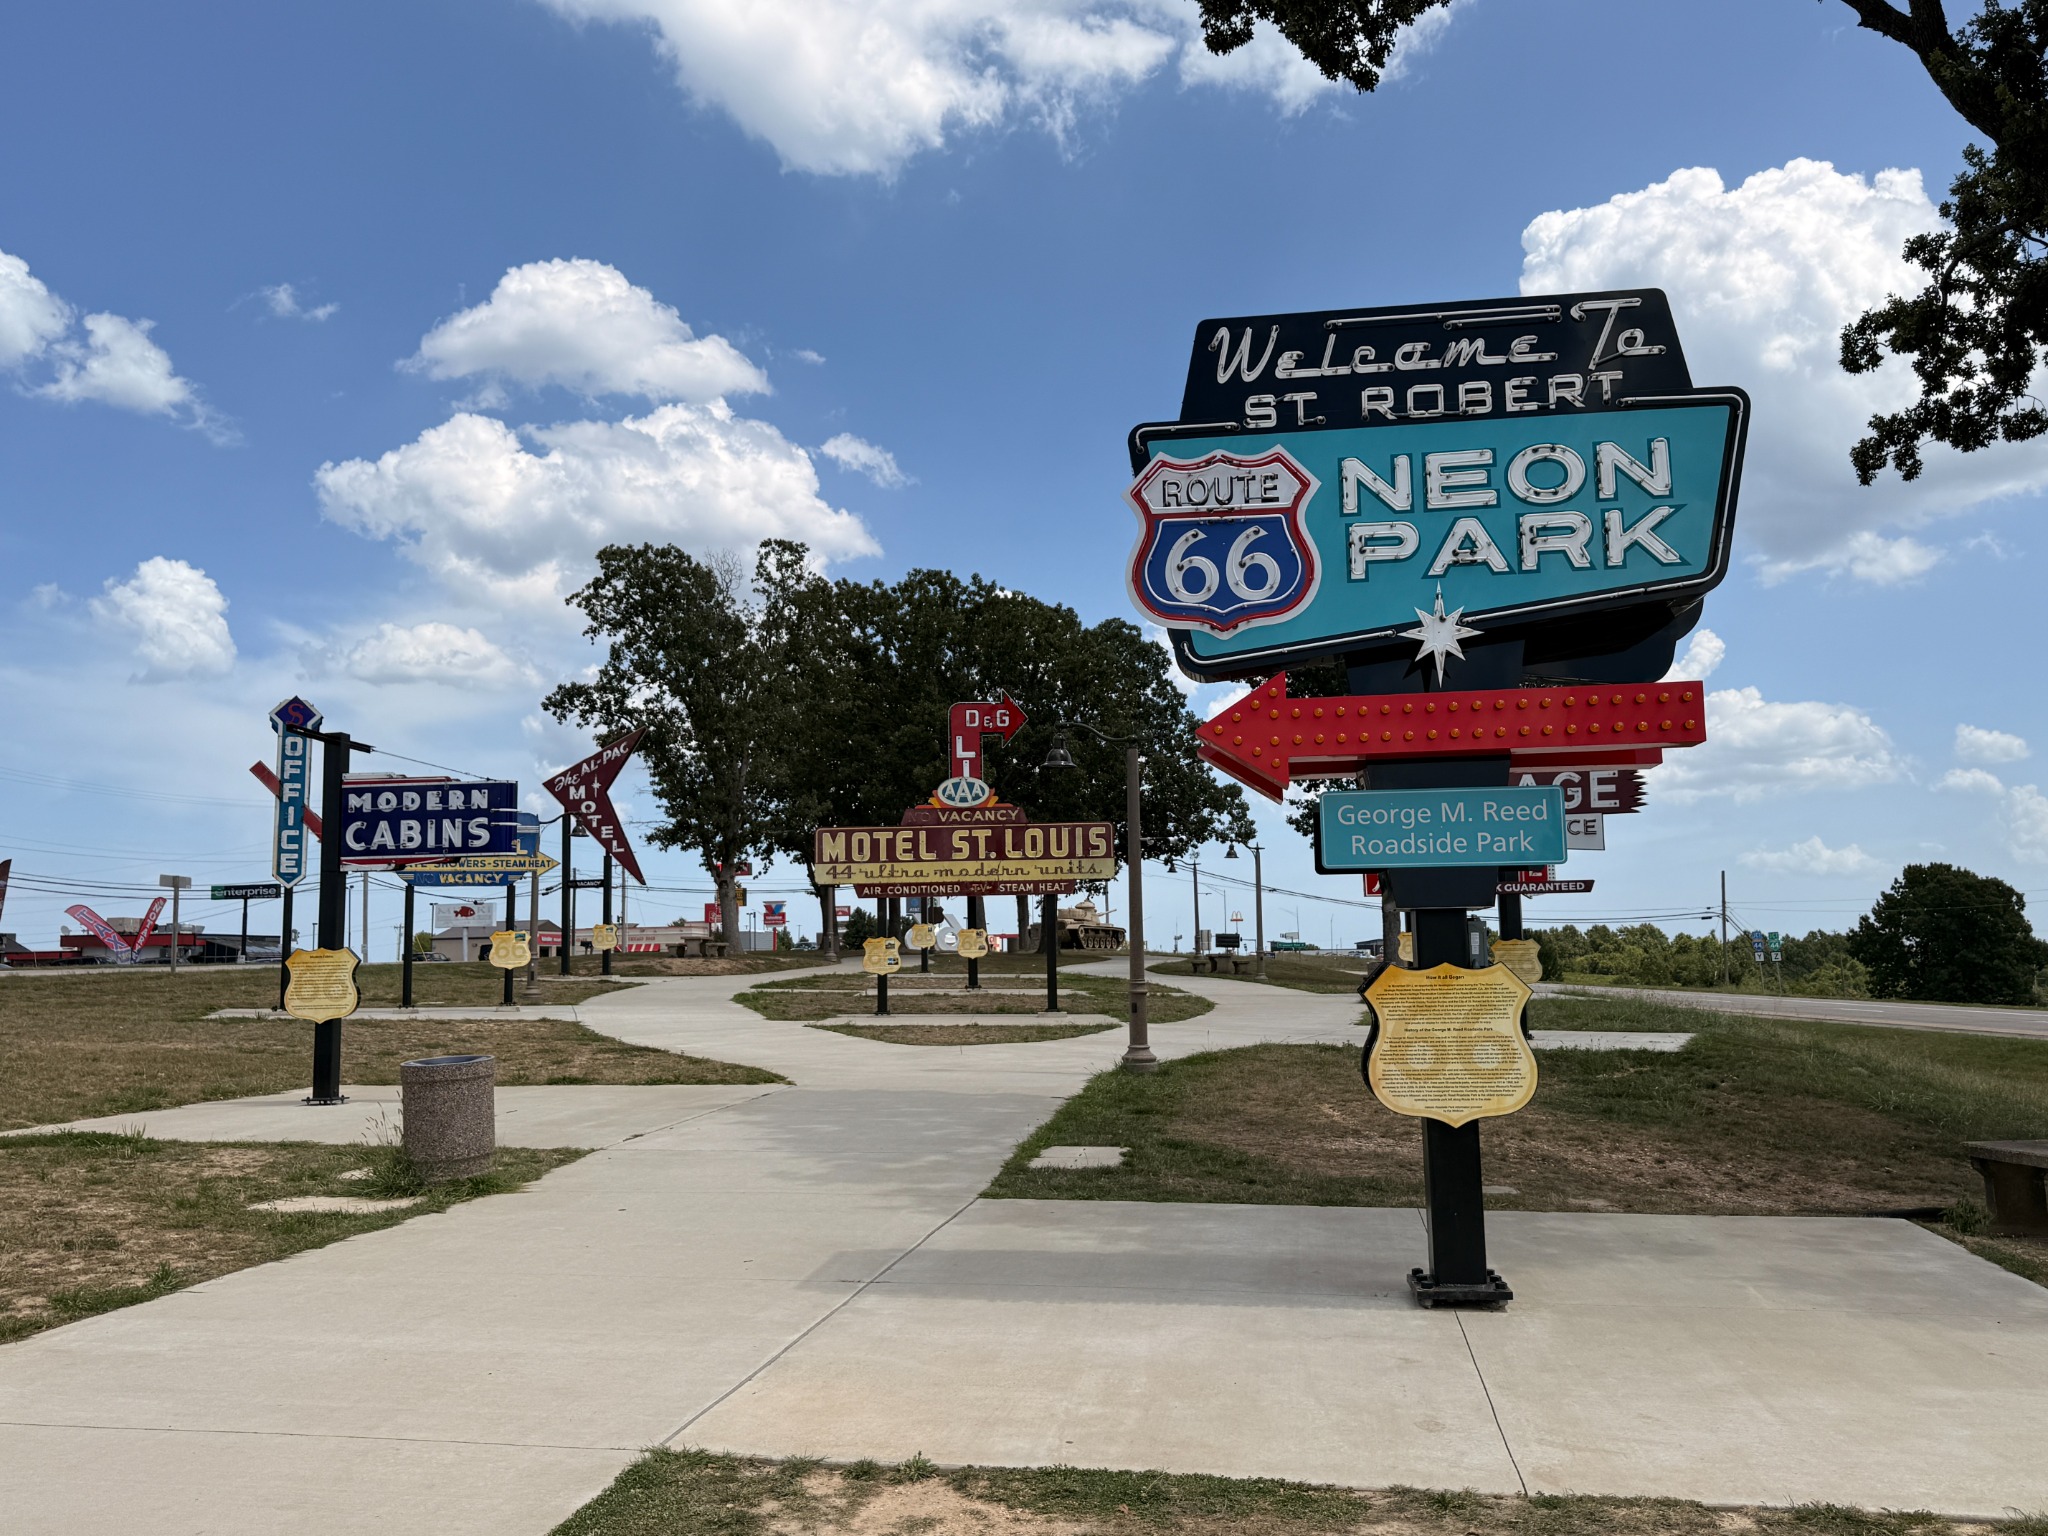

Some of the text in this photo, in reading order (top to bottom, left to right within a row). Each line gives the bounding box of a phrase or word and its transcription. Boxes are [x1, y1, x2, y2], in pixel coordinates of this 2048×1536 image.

[1209, 298, 1667, 384] Welcome To
[1362, 371, 1624, 421] ROBERT
[1163, 472, 1280, 507] ROUTE
[1340, 437, 1672, 514] NEON
[1350, 506, 1682, 580] PARK
[1164, 525, 1282, 603] 66
[554, 741, 629, 792] The AL-PAC
[280, 736, 304, 874] OFFICE
[348, 789, 489, 814] MODERN
[944, 776, 984, 804] AAA
[569, 784, 625, 853] MOTEL
[937, 808, 1020, 823] VACANCY
[1337, 798, 1548, 829] George M. Reed
[346, 816, 491, 852] CABINS
[821, 826, 1107, 862] MOTEL ST. LOUIS
[1352, 829, 1535, 855] Roadside Park
[439, 873, 504, 885] VACANCY
[528, 858, 552, 868] HEAT
[826, 864, 856, 880] 44
[859, 861, 930, 880] ultra
[1034, 858, 1103, 876] units
[215, 887, 277, 898] enterprise
[863, 886, 882, 895] AIR
[887, 884, 961, 895] CONDITIONED
[999, 883, 1035, 893] STEAM
[1038, 882, 1069, 892] HEAT
[1504, 882, 1585, 892] GUARANTEED
[75, 908, 127, 953] TAX
